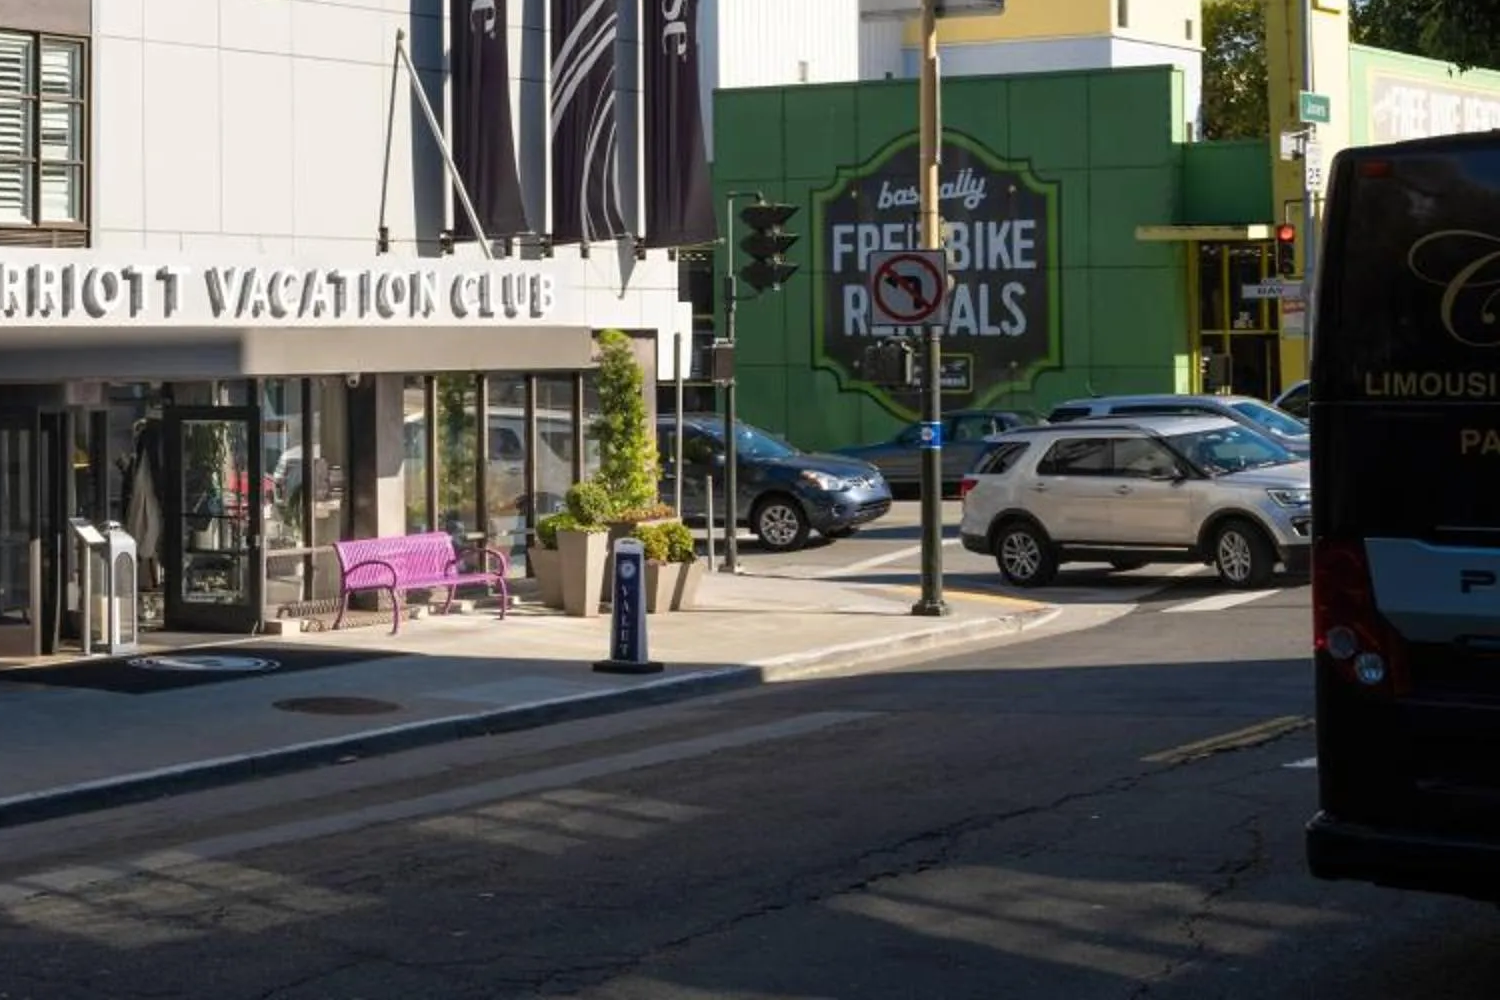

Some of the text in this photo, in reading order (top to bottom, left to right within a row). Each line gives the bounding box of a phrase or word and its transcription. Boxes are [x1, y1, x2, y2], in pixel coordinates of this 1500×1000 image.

[877, 168, 986, 210] basally
[1307, 167, 1321, 185] 25
[946, 219, 1037, 270] BIKE
[204, 265, 438, 319] VACATION
[450, 269, 556, 319] CLUB
[844, 281, 1027, 336] RALS
[1459, 569, 1497, 594] P
